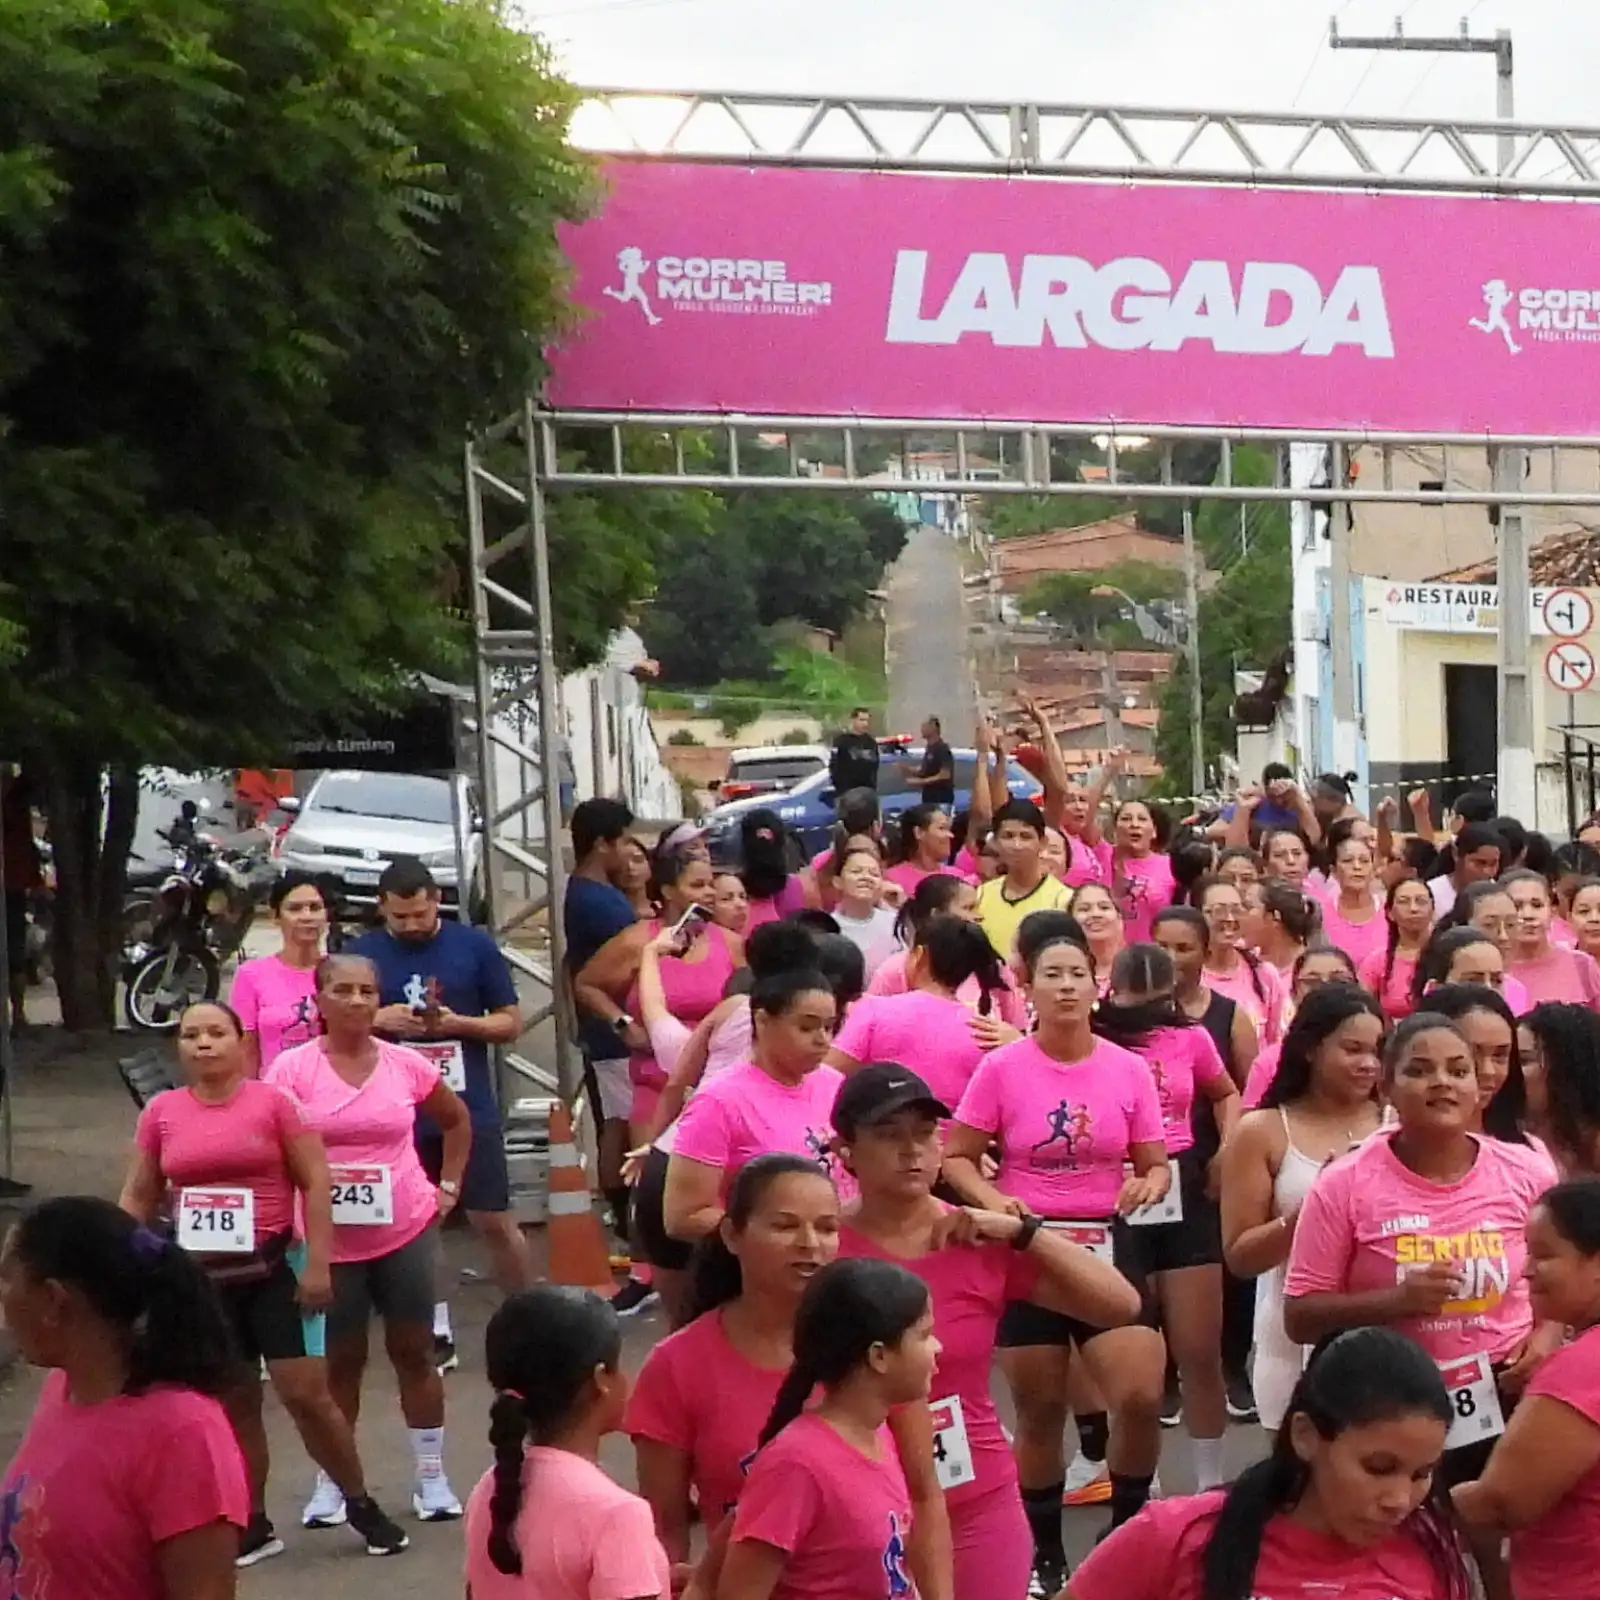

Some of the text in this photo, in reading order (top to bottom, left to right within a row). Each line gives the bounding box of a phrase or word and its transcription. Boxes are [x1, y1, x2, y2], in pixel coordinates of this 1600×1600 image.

[657, 257, 786, 281] CORRE
[657, 280, 832, 305] MULHER!
[885, 249, 1395, 358] LARGADA
[332, 1185, 375, 1206] 243
[191, 1210, 235, 1231] 218
